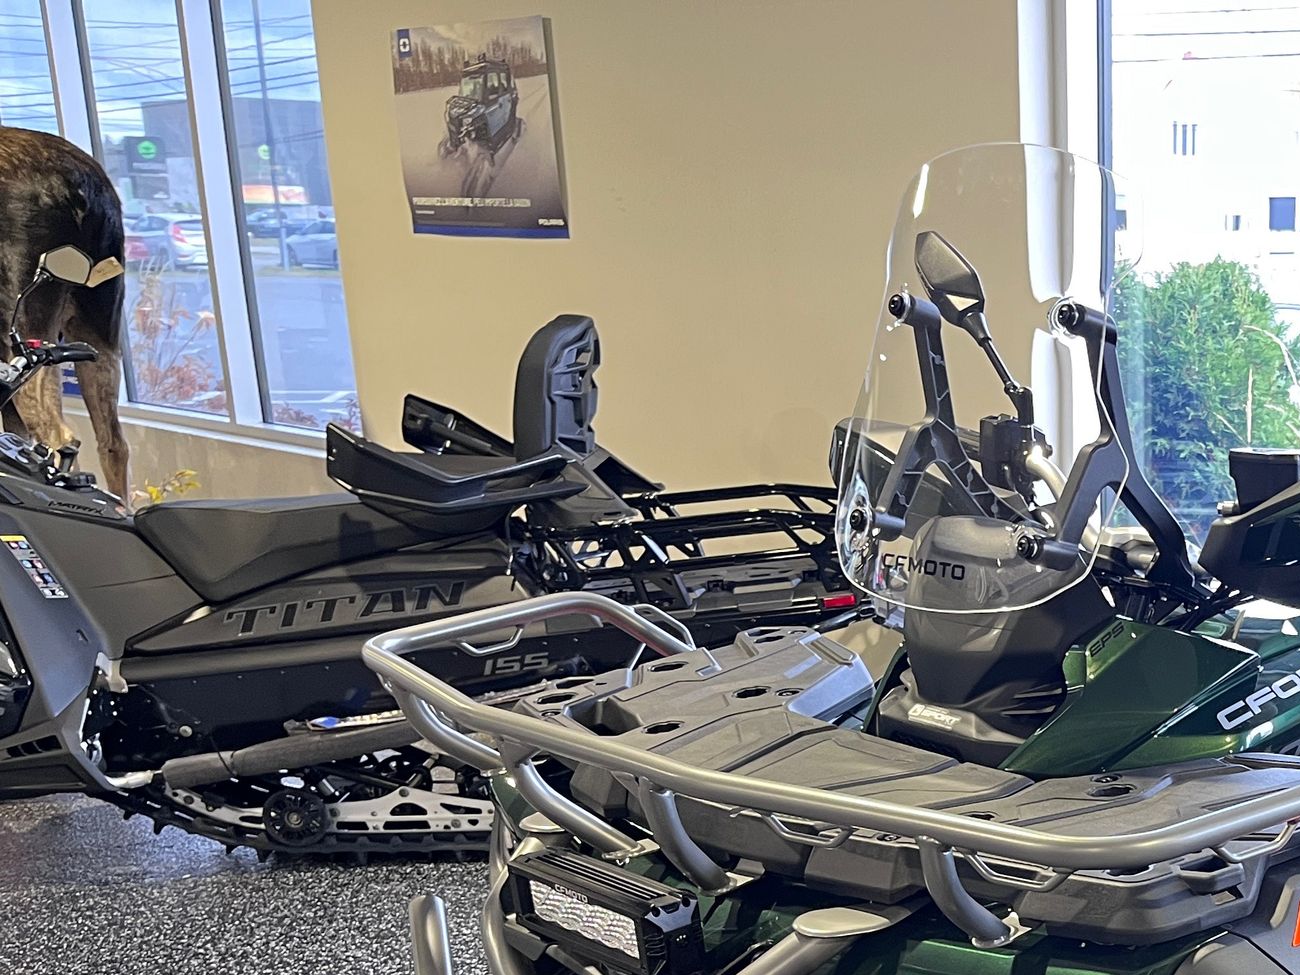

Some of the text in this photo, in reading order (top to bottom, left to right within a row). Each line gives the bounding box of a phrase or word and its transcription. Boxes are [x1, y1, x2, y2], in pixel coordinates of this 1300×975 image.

[882, 553, 966, 581] CFMOTO
[223, 581, 468, 637] TITAN
[1089, 620, 1125, 658] EPS
[483, 652, 550, 677] 155
[554, 883, 589, 904] CFMOTO
